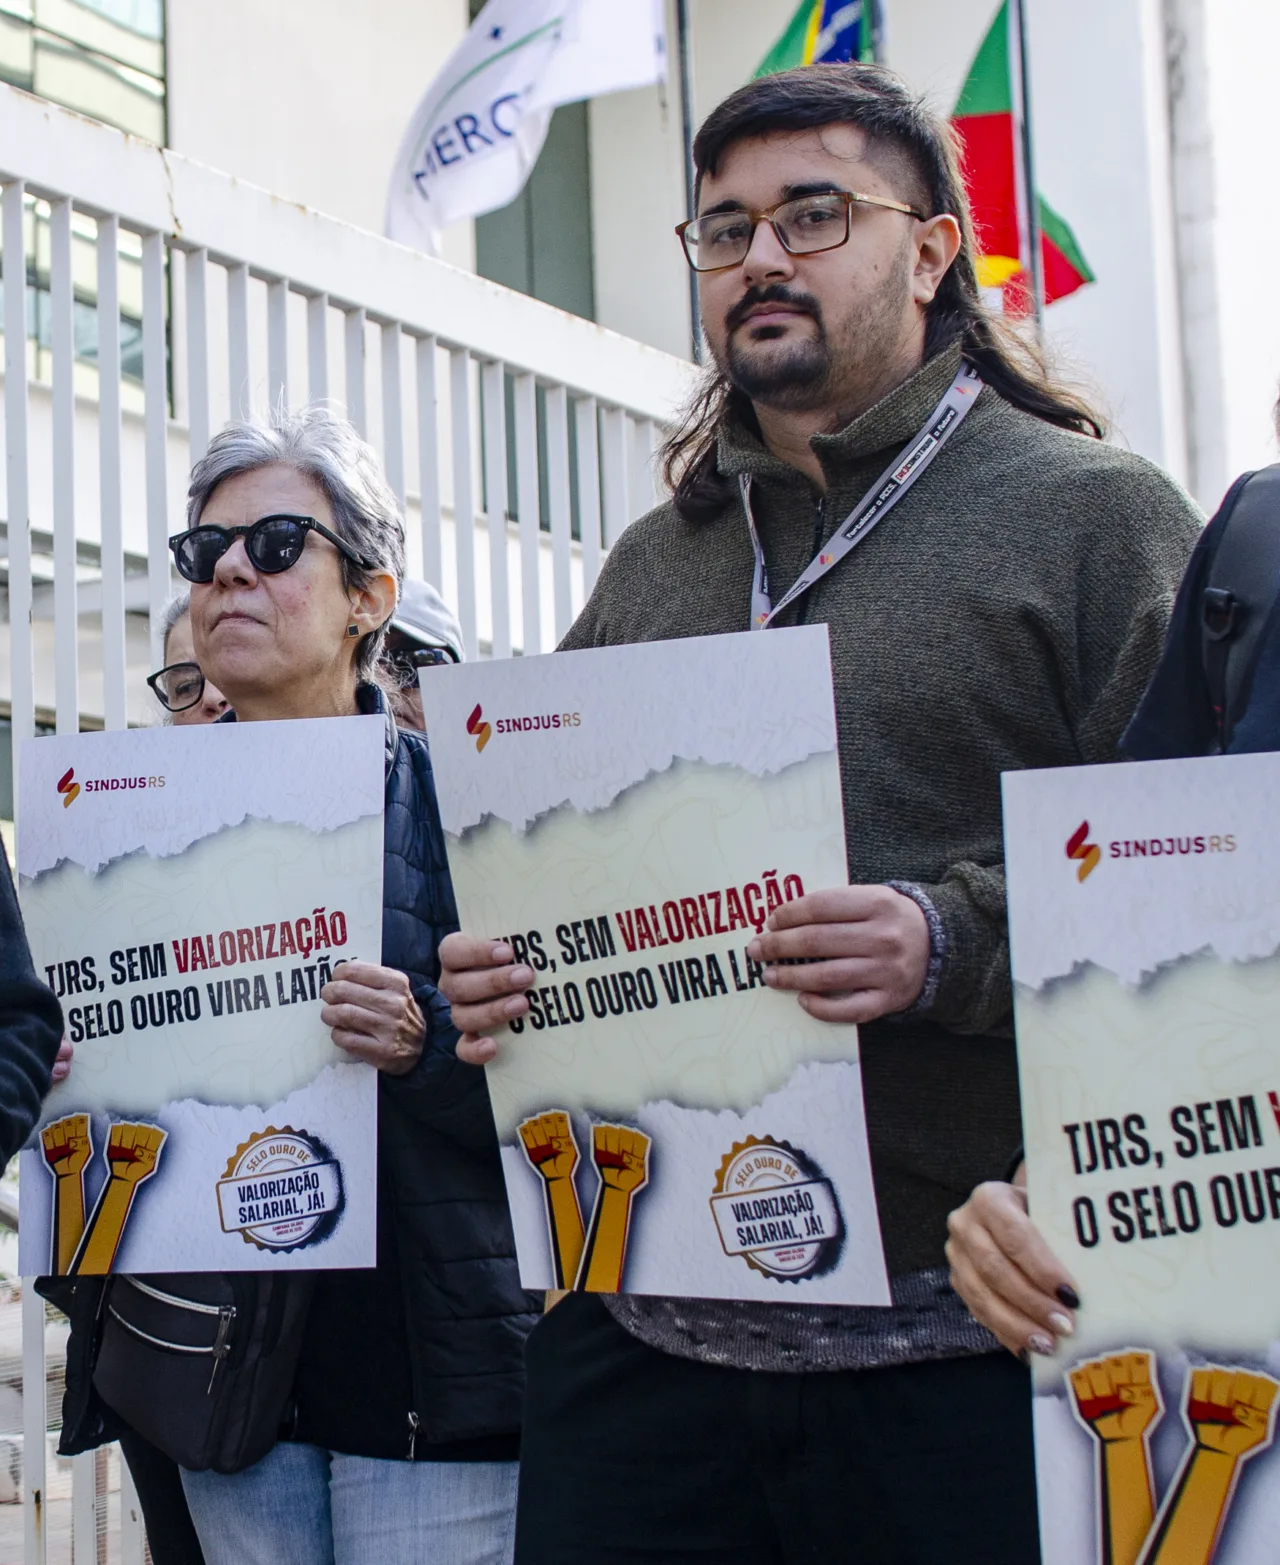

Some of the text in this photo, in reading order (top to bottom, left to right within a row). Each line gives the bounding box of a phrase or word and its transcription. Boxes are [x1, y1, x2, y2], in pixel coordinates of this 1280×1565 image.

[412, 86, 532, 201] MERC
[44, 906, 348, 998] TJRS, SEM VALORIZAÇÃO
[555, 915, 617, 965] SEM
[68, 955, 357, 1043] SELO OURO VIRA LATÃ
[524, 981, 585, 1030] SELO
[585, 967, 658, 1019] OURO
[658, 953, 728, 1005] VIRA
[247, 1144, 310, 1172] SELO OURO DE
[1062, 1113, 1165, 1175] TJRS,
[1170, 1095, 1264, 1158] SEM
[238, 1171, 320, 1203] VALORIZAÇÃO
[735, 1156, 799, 1187] SELO OURO DE
[238, 1190, 325, 1224] SALARIAL, JÁ!
[731, 1189, 814, 1223] VALORIZAÇÃO
[736, 1212, 825, 1247] SALARIAL, JÁ!
[1073, 1167, 1280, 1249] O SELO OUR
